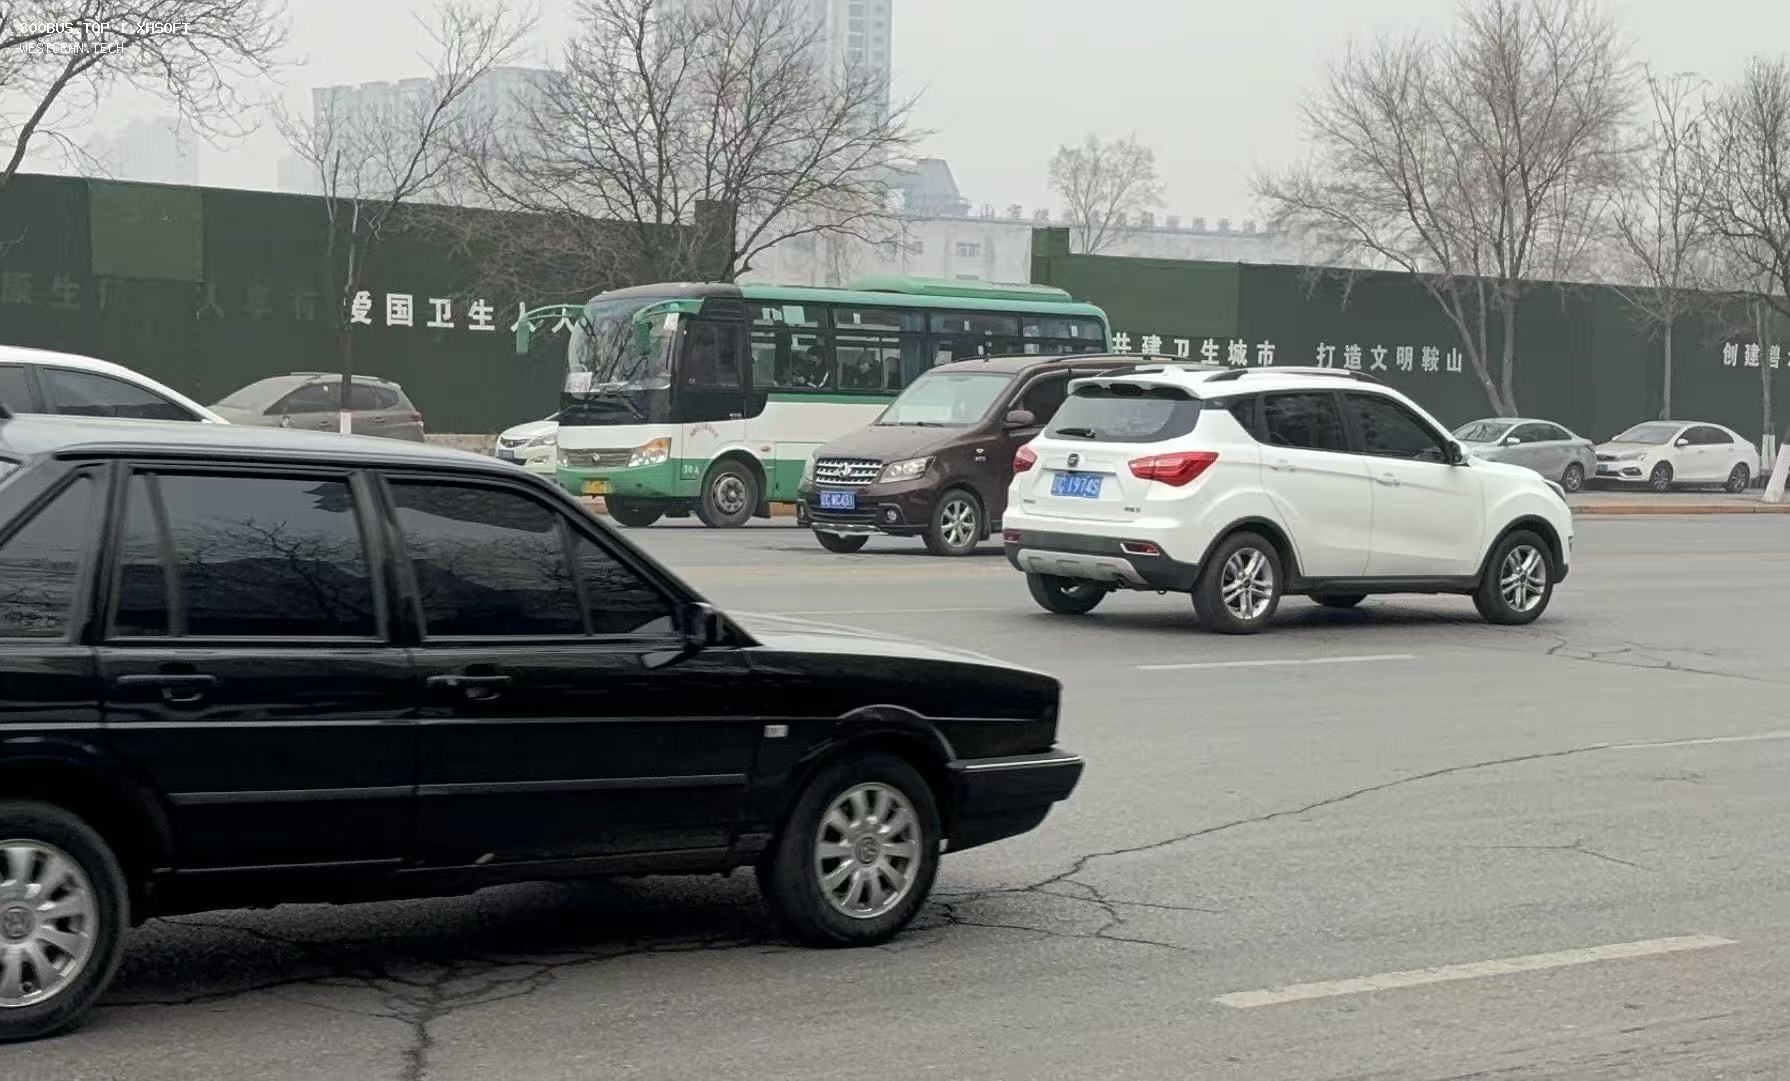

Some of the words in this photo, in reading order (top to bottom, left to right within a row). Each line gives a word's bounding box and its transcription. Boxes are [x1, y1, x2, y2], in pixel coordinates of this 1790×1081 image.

[1316, 342, 1463, 372] 打造文明鞍山
